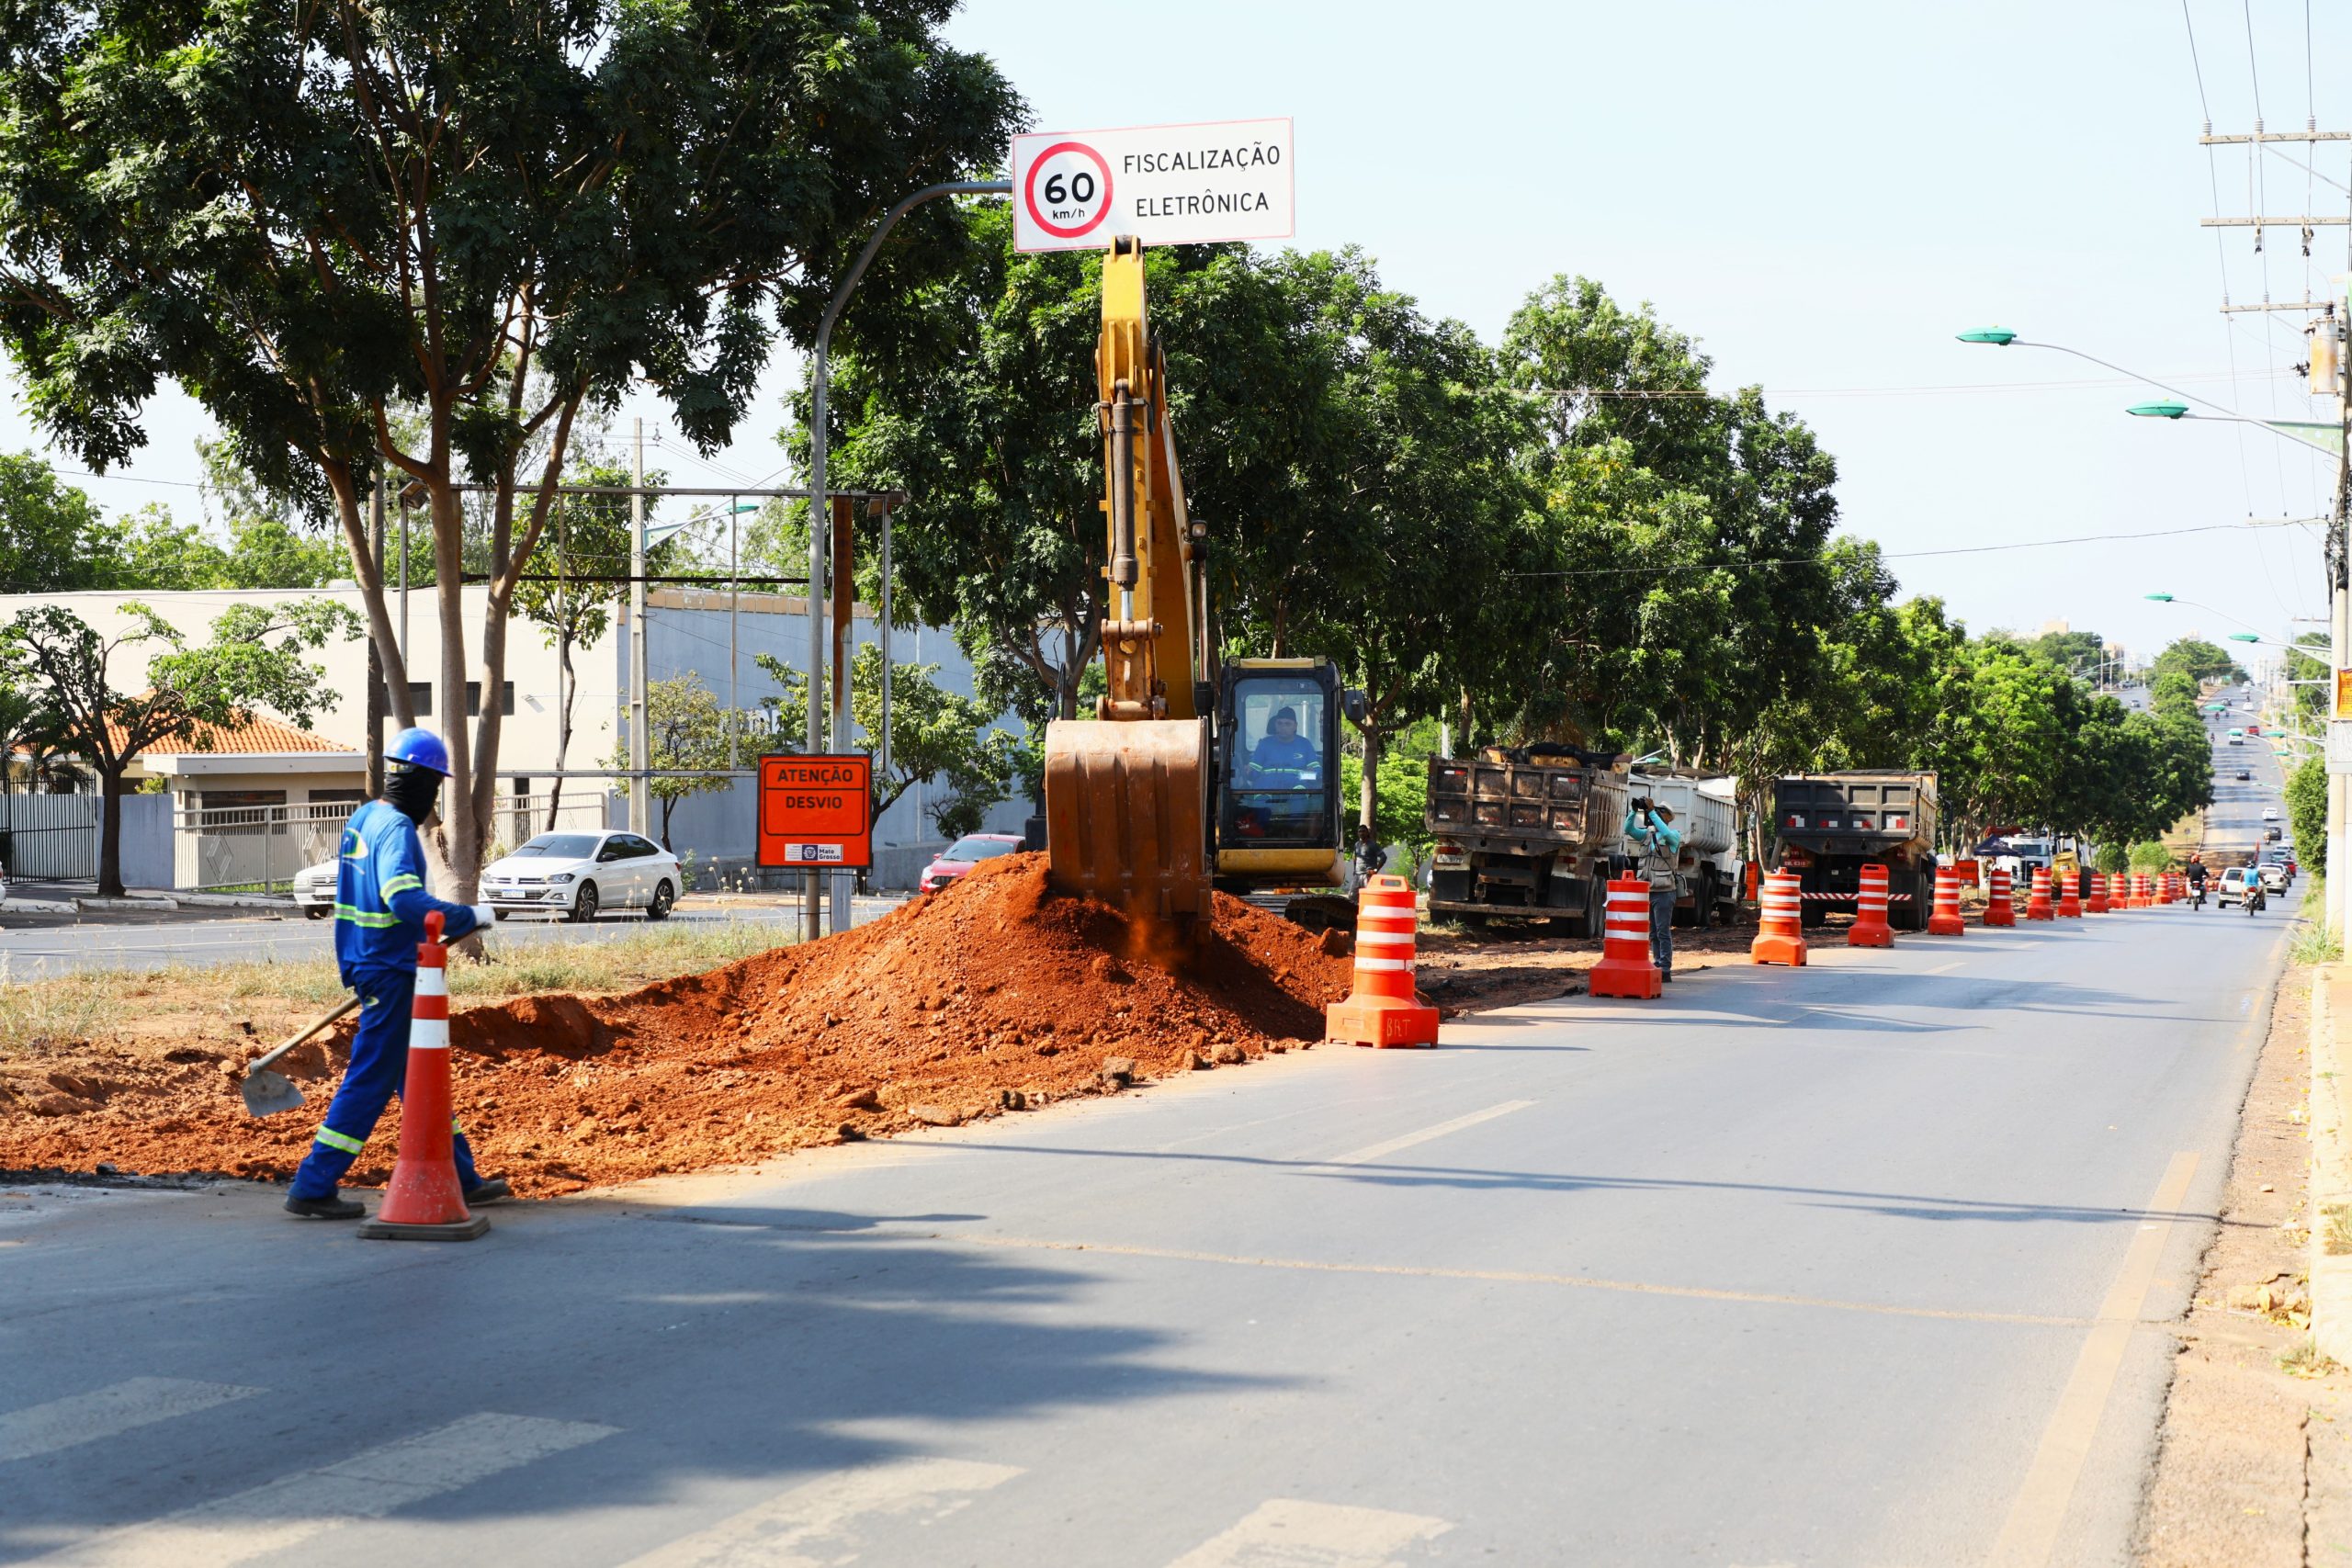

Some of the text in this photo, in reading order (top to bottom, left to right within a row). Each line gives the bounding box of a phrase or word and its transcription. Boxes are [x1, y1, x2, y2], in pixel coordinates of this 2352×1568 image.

[1124, 141, 1280, 175] FISCALIZAÇÃO
[1044, 172, 1095, 205] 60
[1052, 208, 1086, 220] km/h
[1136, 188, 1270, 218] ELETRÔNICA
[777, 766, 854, 786] ATENÇÃO
[786, 796, 842, 809] DESVIO
